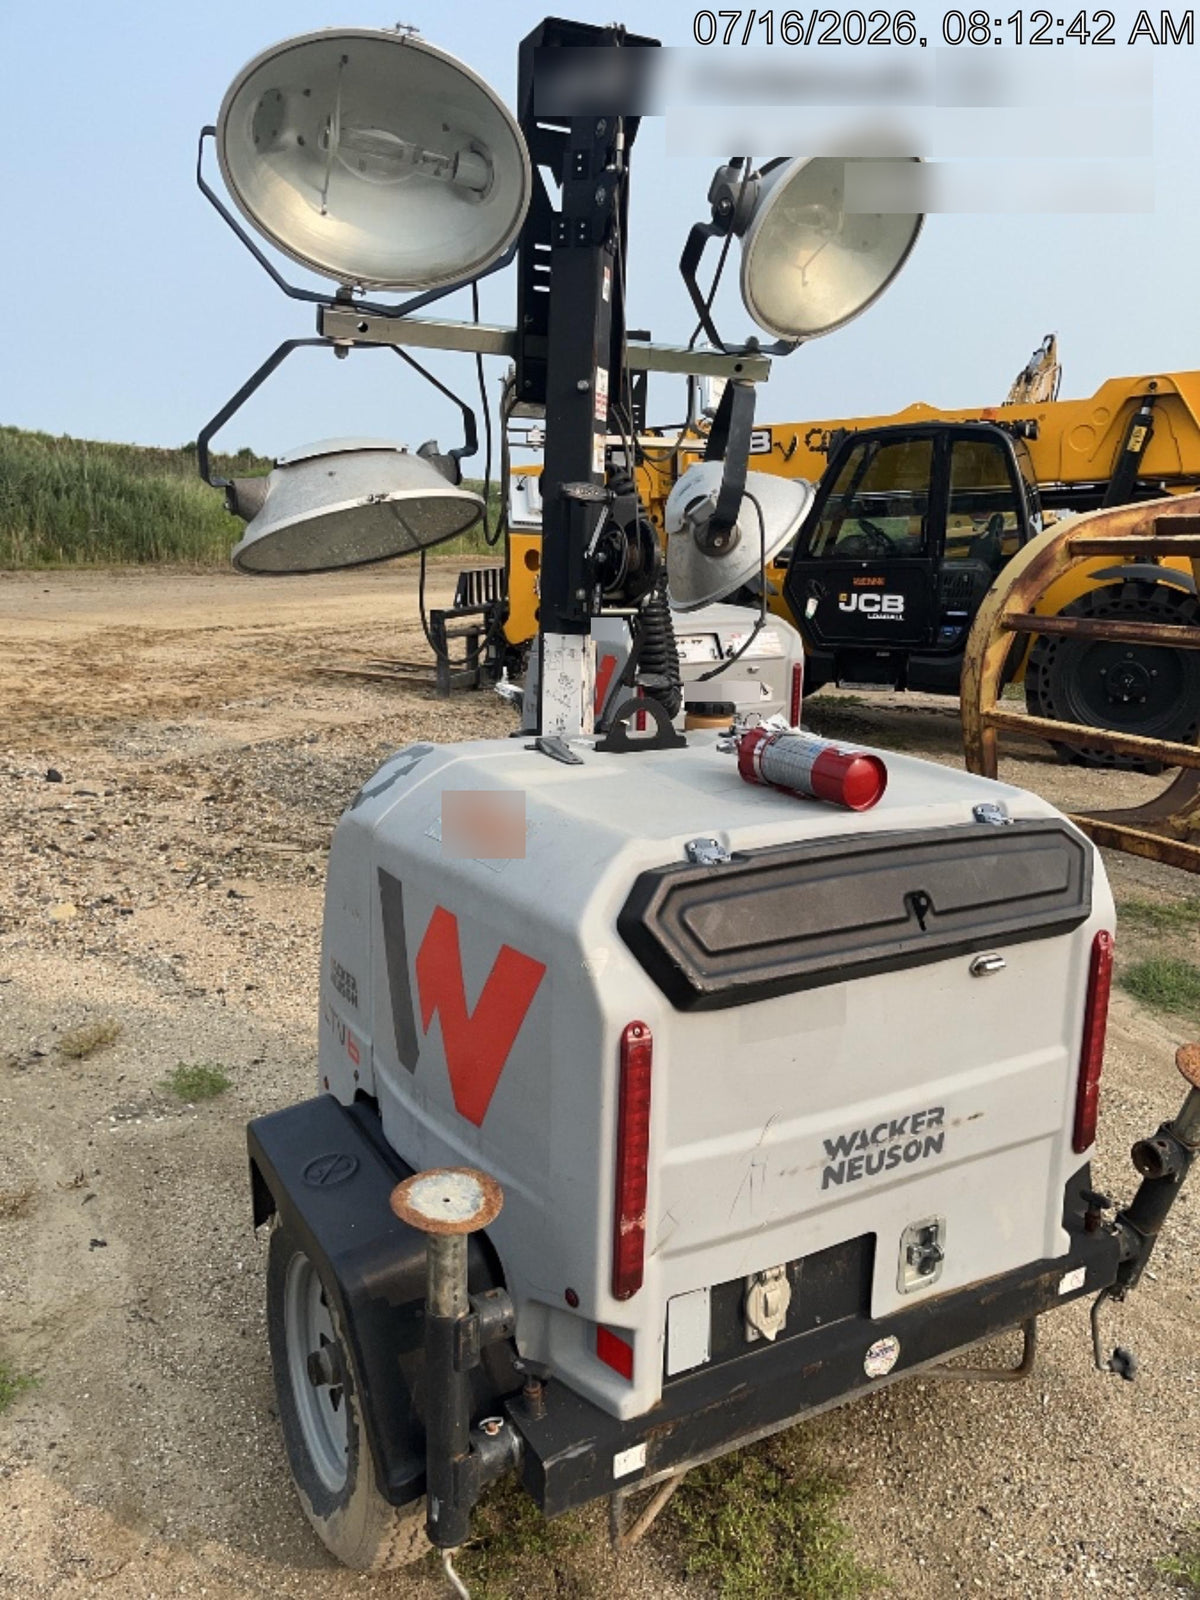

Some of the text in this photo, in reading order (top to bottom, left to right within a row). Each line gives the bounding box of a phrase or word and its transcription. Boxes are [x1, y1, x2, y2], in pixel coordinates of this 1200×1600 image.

[839, 593, 904, 612] JCB
[821, 1132, 945, 1190] NEUSON
[823, 1107, 945, 1161] WACKER
